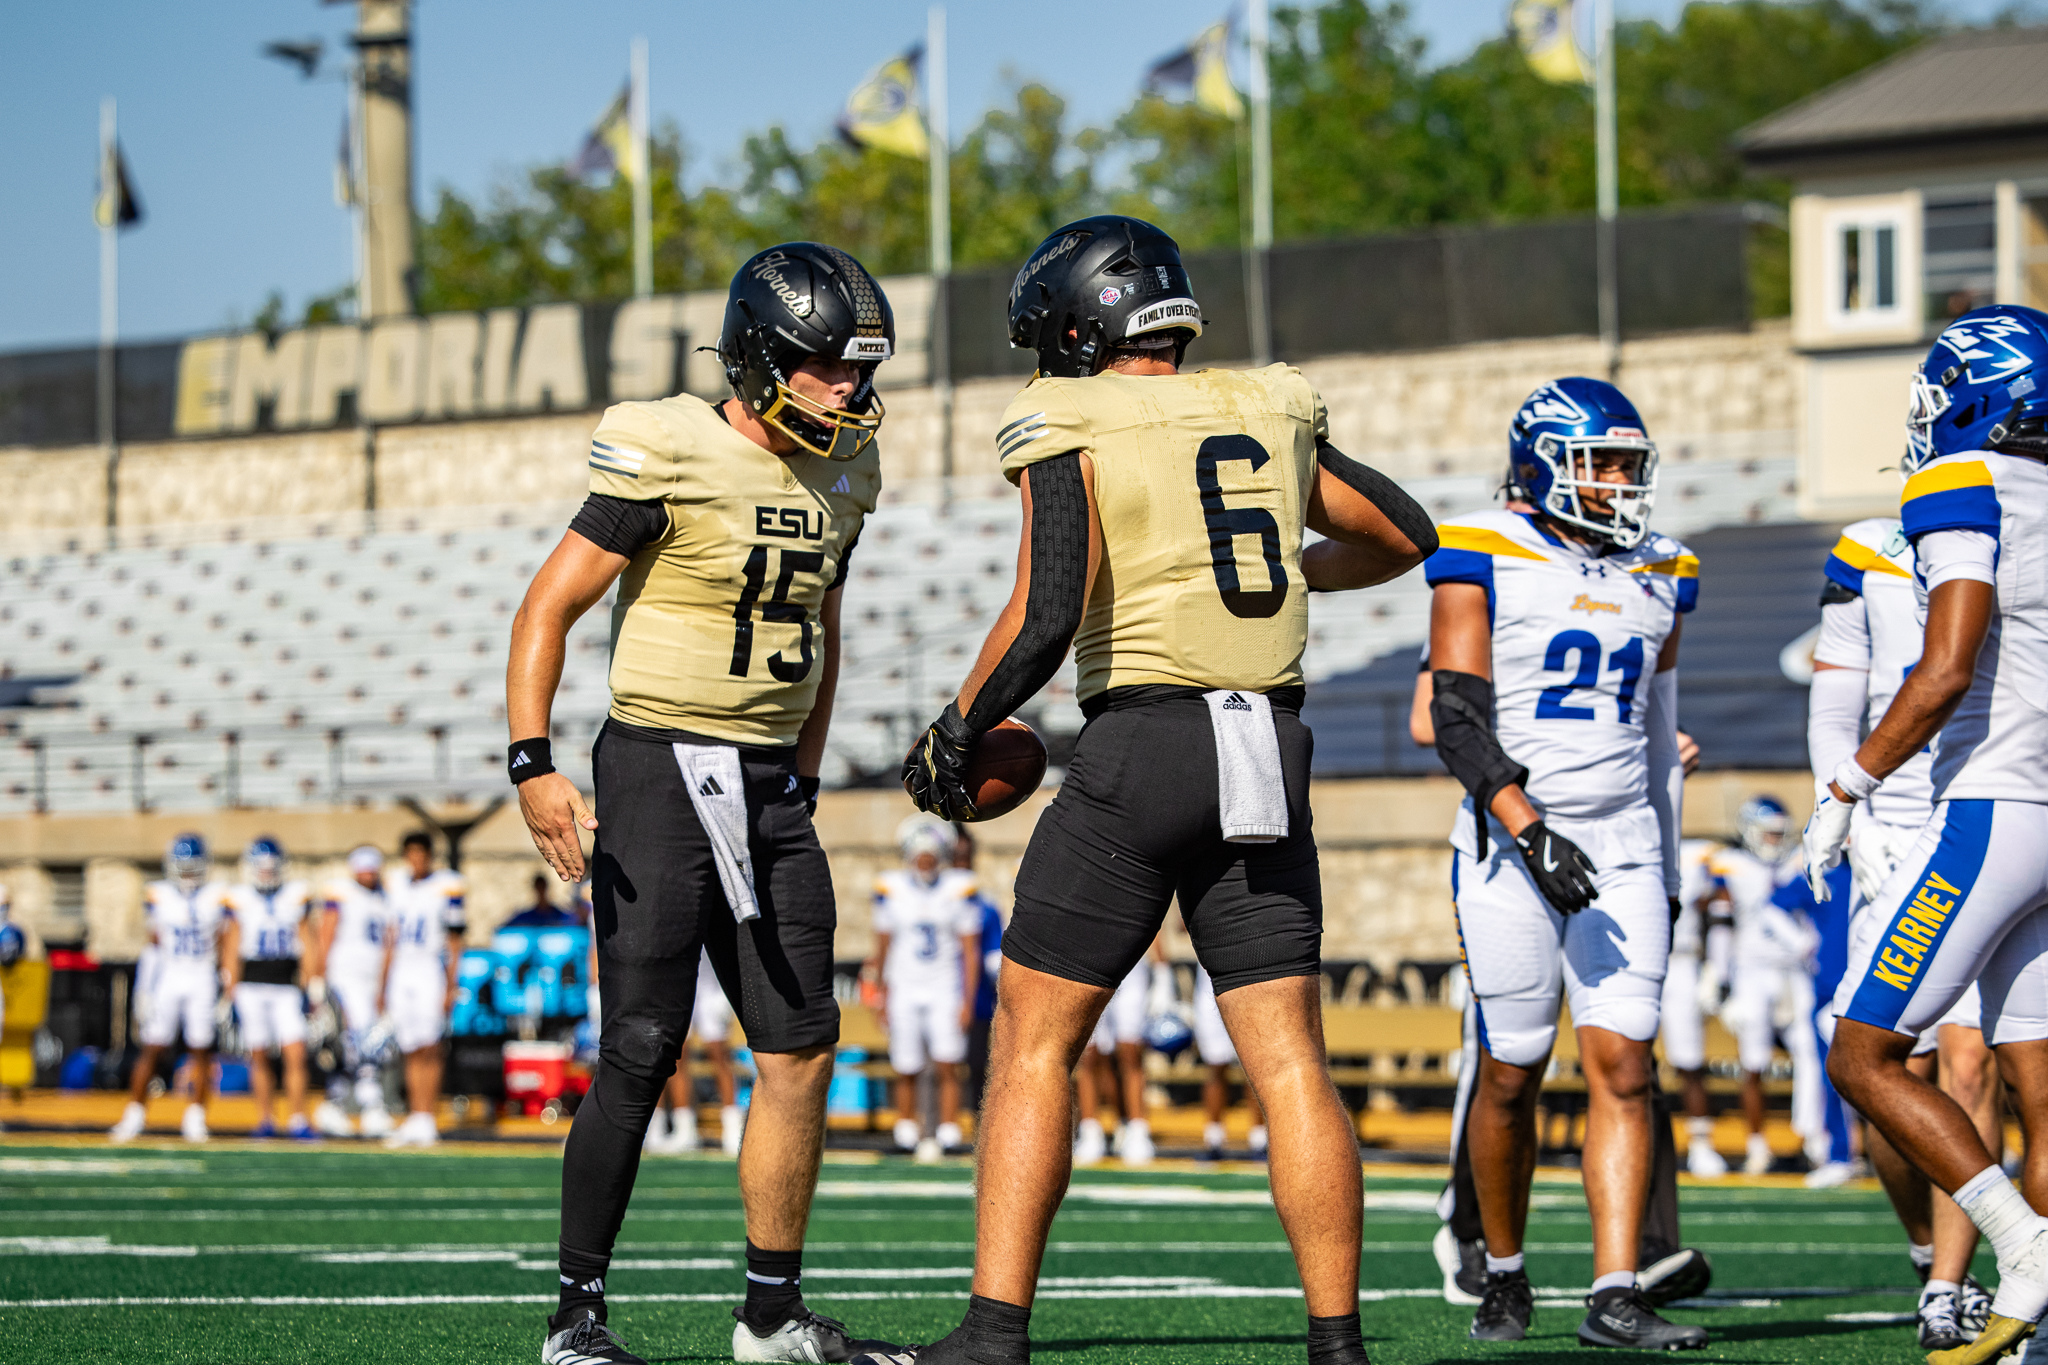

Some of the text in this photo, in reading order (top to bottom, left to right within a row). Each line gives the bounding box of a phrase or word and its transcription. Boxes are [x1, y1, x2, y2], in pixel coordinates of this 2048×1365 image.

[752, 251, 812, 318] Hornets
[1009, 236, 1080, 308] Hornets
[1102, 292, 1118, 301] MIAA
[857, 342, 884, 353] MTXE
[1138, 306, 1165, 328] FAMILY
[1166, 304, 1185, 317] OVER
[173, 304, 590, 435] EMPORIA
[755, 505, 824, 541] ESU
[1196, 433, 1289, 618] 6
[729, 546, 825, 683] 15
[1222, 702, 1252, 712] adidas
[1535, 629, 1644, 725] 21
[1873, 871, 1962, 991] KEARNEY
